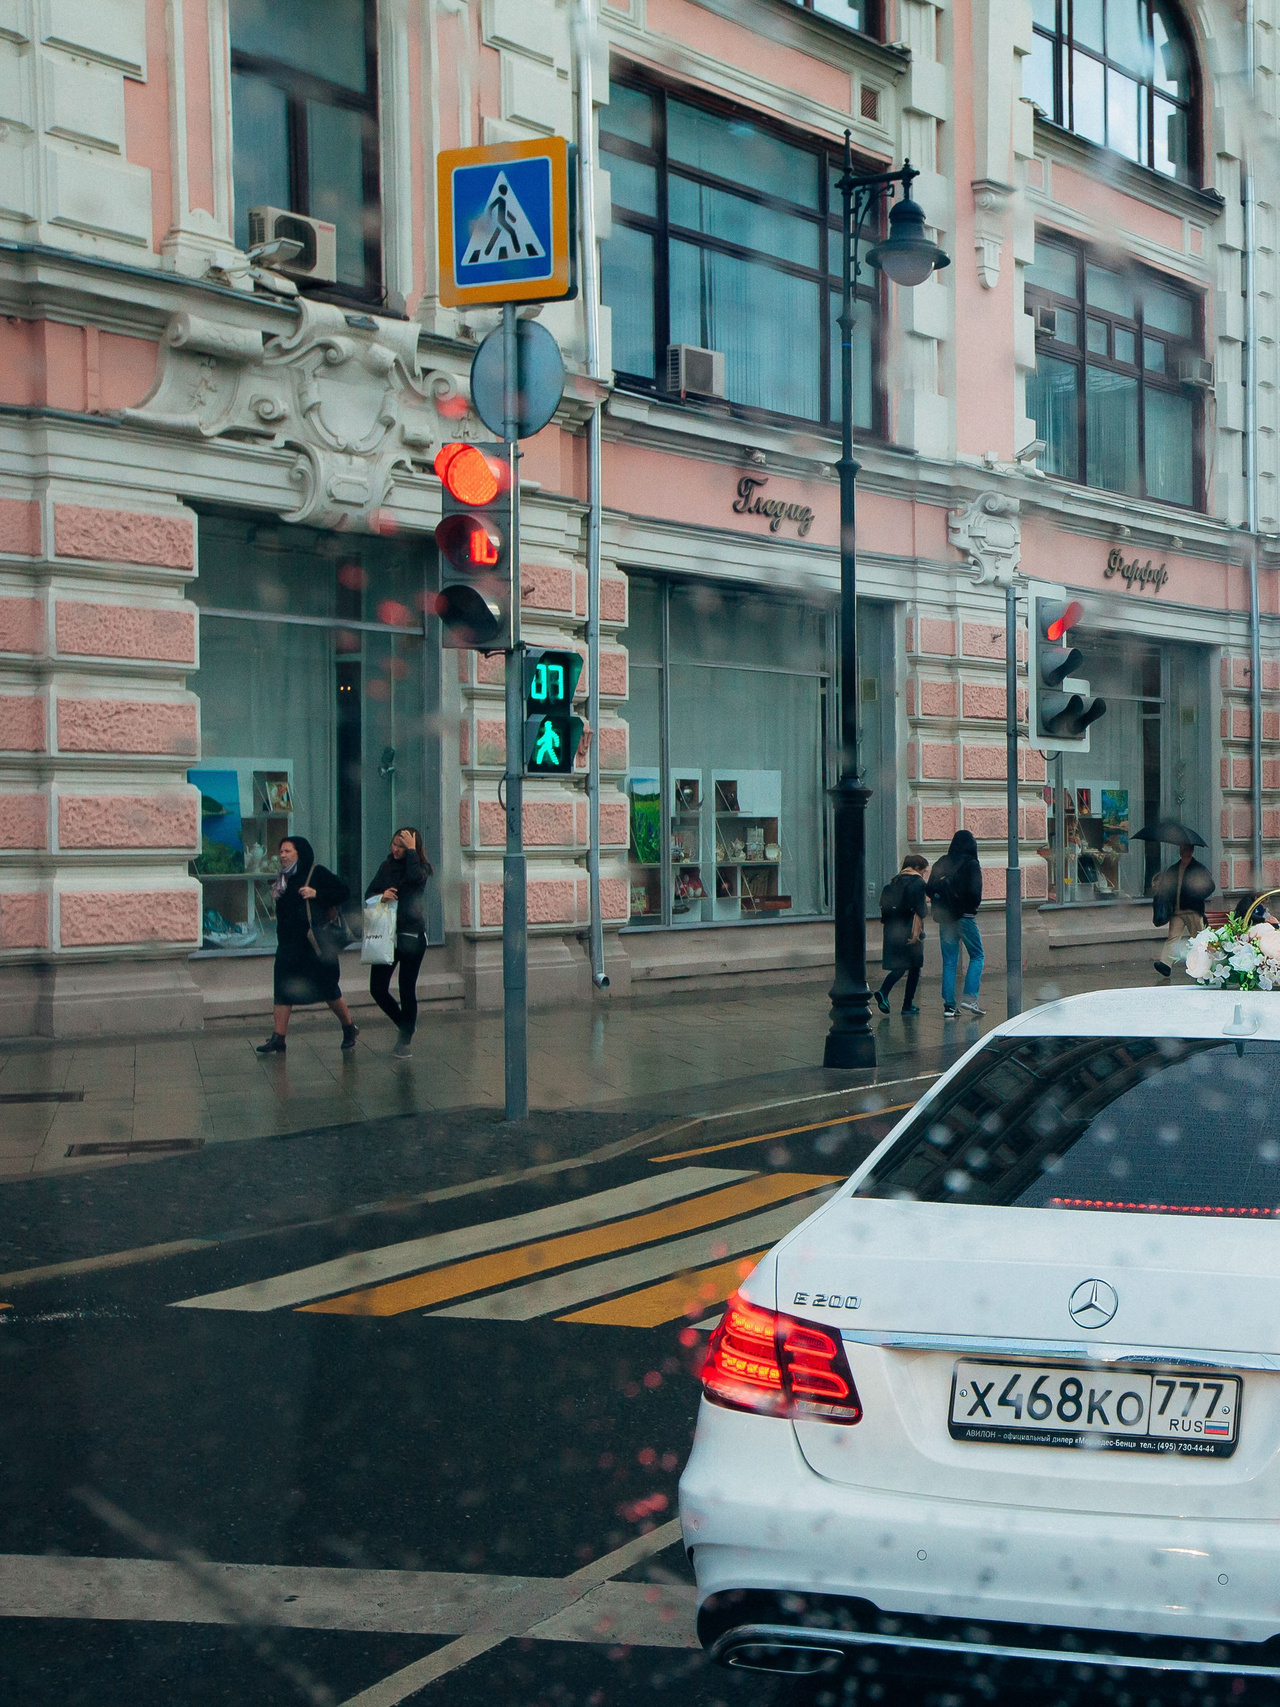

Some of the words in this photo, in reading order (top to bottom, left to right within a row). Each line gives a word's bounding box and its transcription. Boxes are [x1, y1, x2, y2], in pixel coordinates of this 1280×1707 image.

[793, 1292, 809, 1305] E
[812, 1294, 861, 1309] 200
[1156, 1380, 1224, 1418] 777
[1169, 1419, 1203, 1433] RUS
[966, 1429, 996, 1438] АВИЛОН
[1003, 1432, 1051, 1442] официальный
[1052, 1437, 1074, 1445] дилер
[1157, 1442, 1176, 1451] (495)
